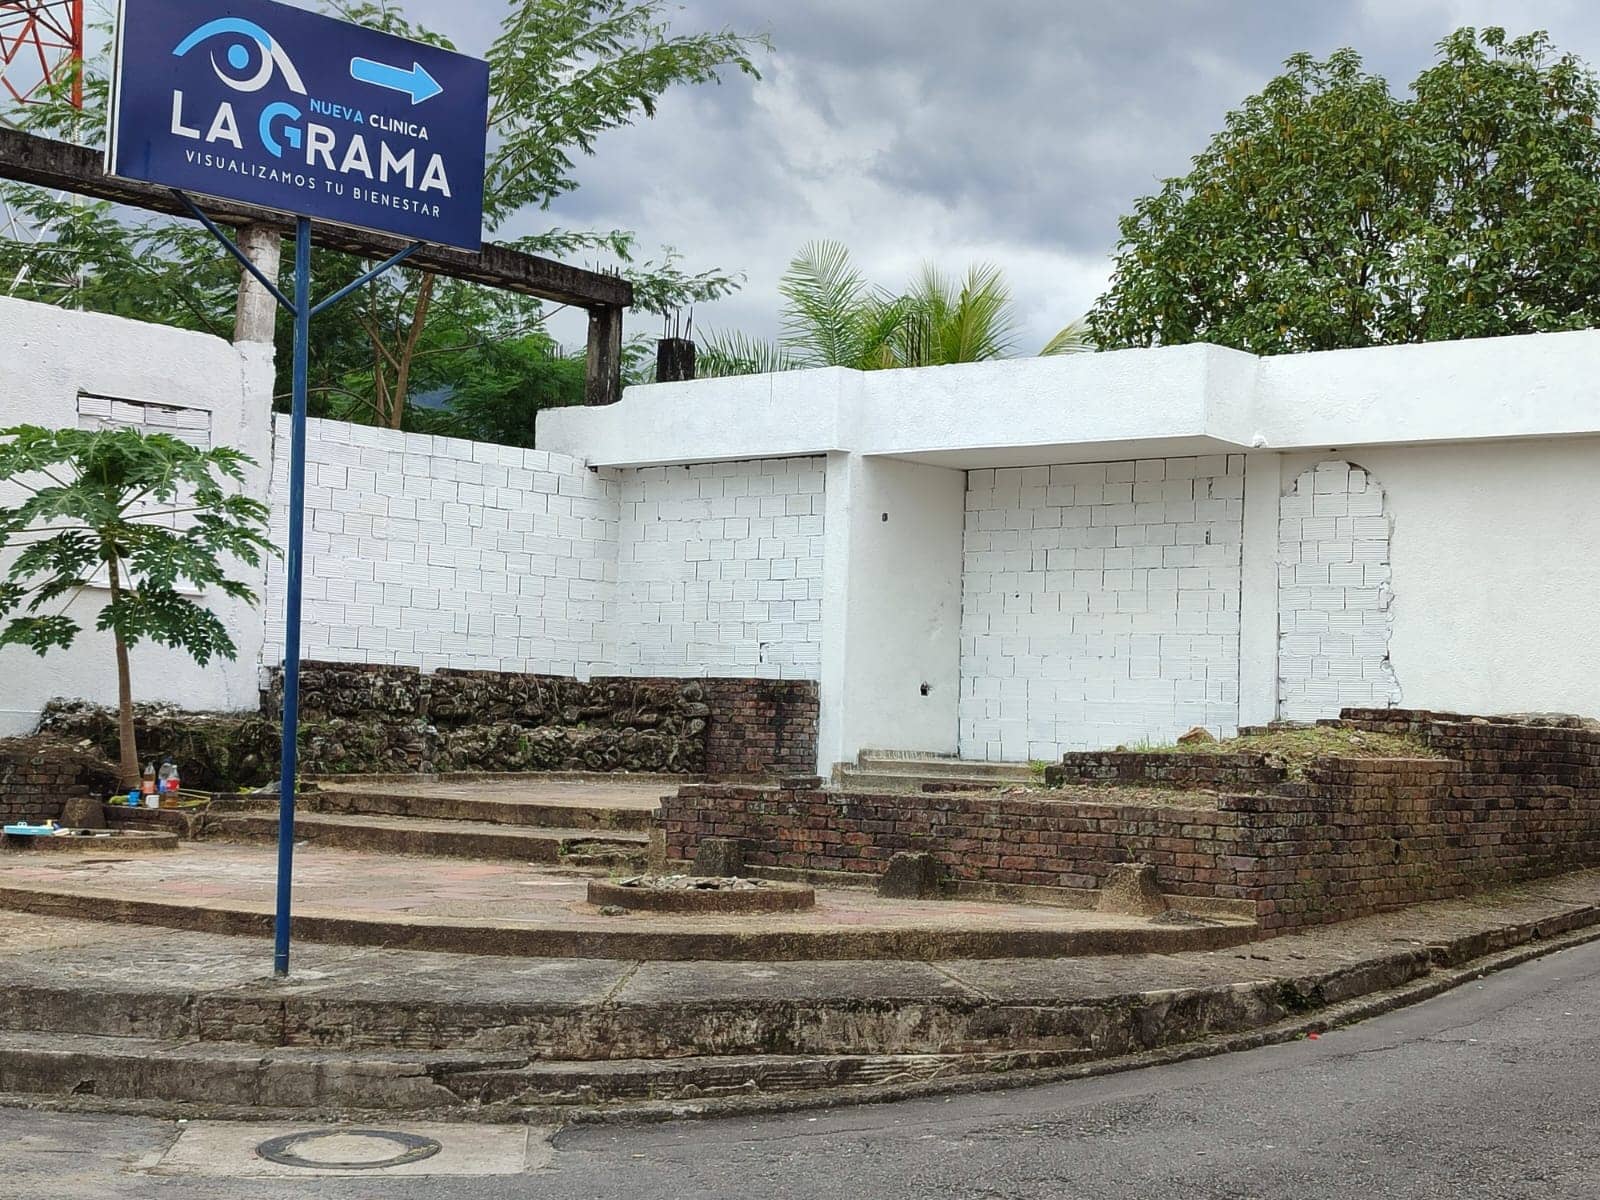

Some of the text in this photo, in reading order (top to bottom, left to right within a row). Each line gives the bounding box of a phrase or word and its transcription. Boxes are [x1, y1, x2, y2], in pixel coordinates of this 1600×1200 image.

[171, 89, 452, 198] LA GRAMA
[310, 98, 429, 141] NUEVA CLINICA
[185, 150, 440, 218] VISUALIZAMOS TU BIENESTAR
